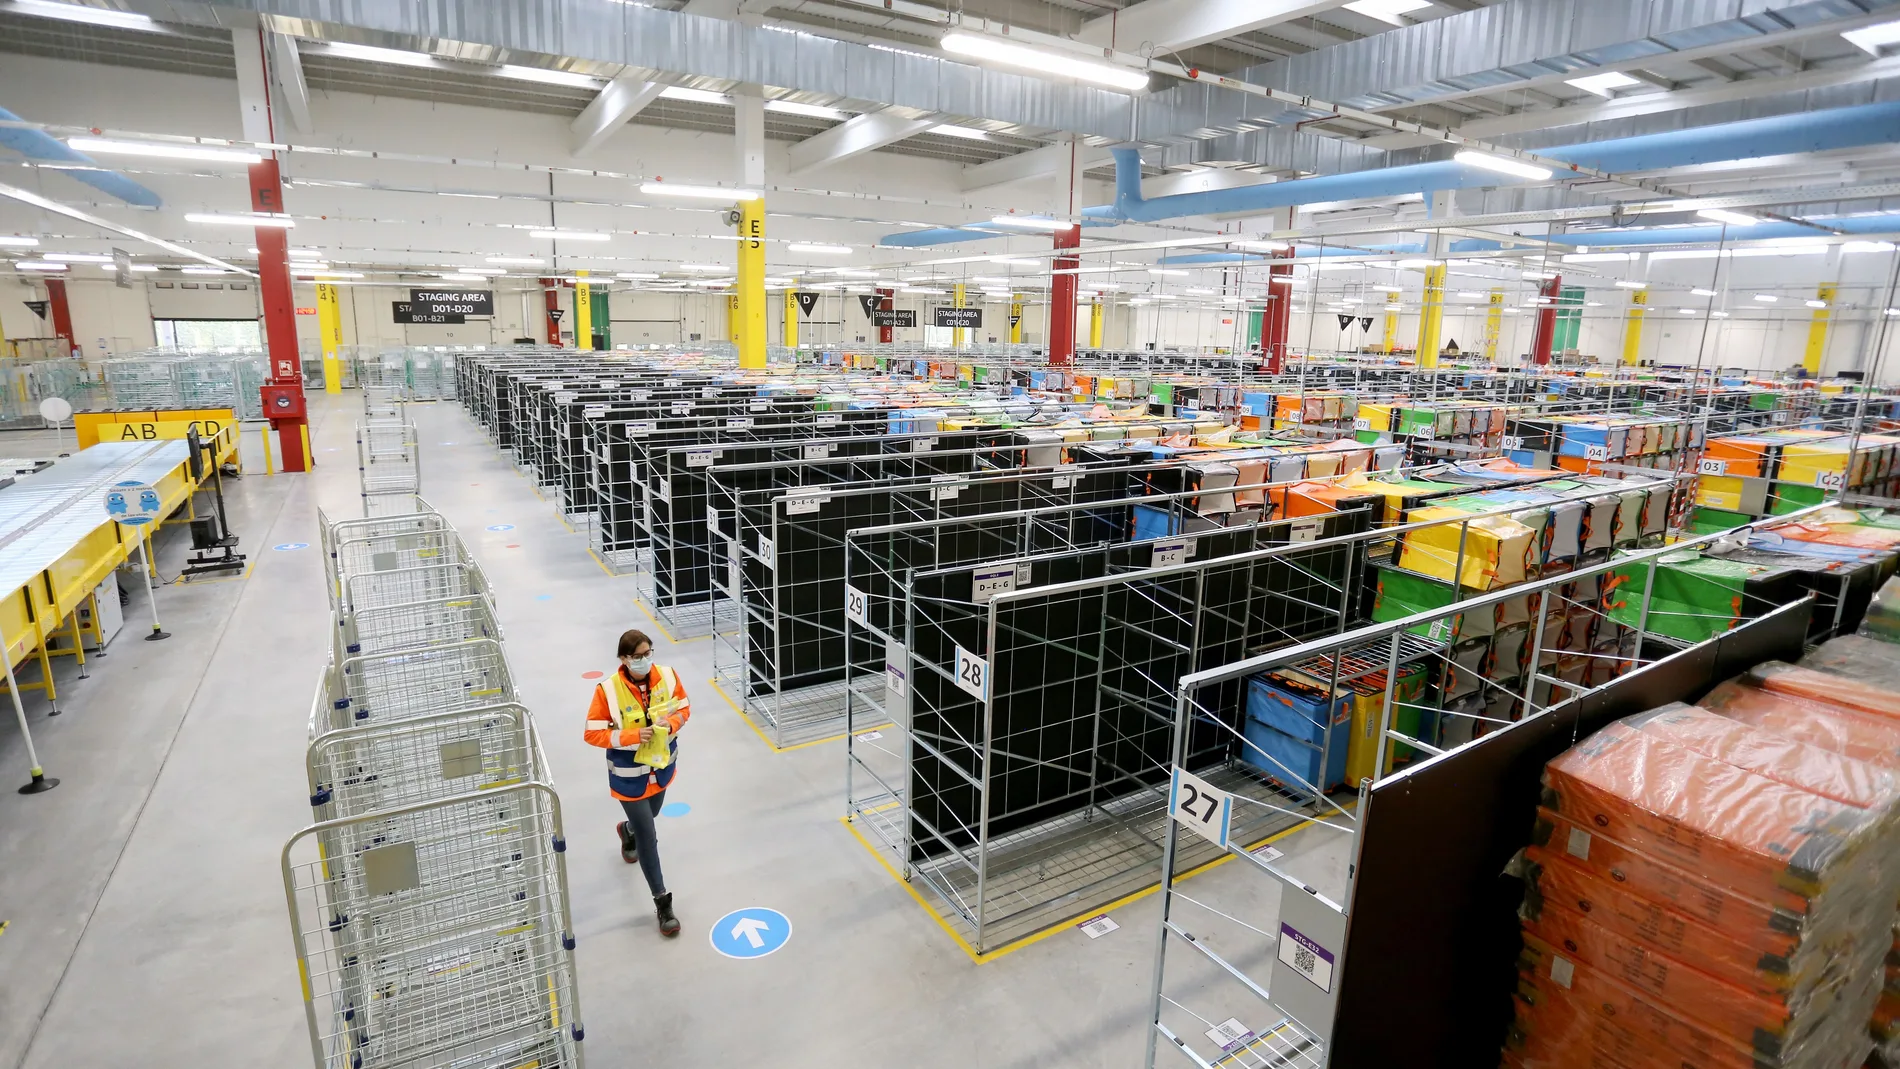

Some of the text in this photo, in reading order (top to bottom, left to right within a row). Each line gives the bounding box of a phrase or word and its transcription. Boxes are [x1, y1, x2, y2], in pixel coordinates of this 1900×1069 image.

[418, 293, 486, 302] STAGING AREA
[803, 295, 811, 304] D
[432, 305, 474, 313] D01-D20
[412, 314, 445, 322] B01-B21
[1356, 420, 1367, 428] 07
[121, 423, 157, 441] AB
[1420, 427, 1431, 436] 06
[1589, 447, 1602, 458] 04
[1703, 460, 1719, 472] 03
[709, 511, 716, 527] 31
[761, 541, 771, 560] 30
[849, 592, 863, 616] 29
[961, 657, 981, 688] 28
[1180, 783, 1219, 824] 27
[1294, 932, 1320, 954] STG-E32
